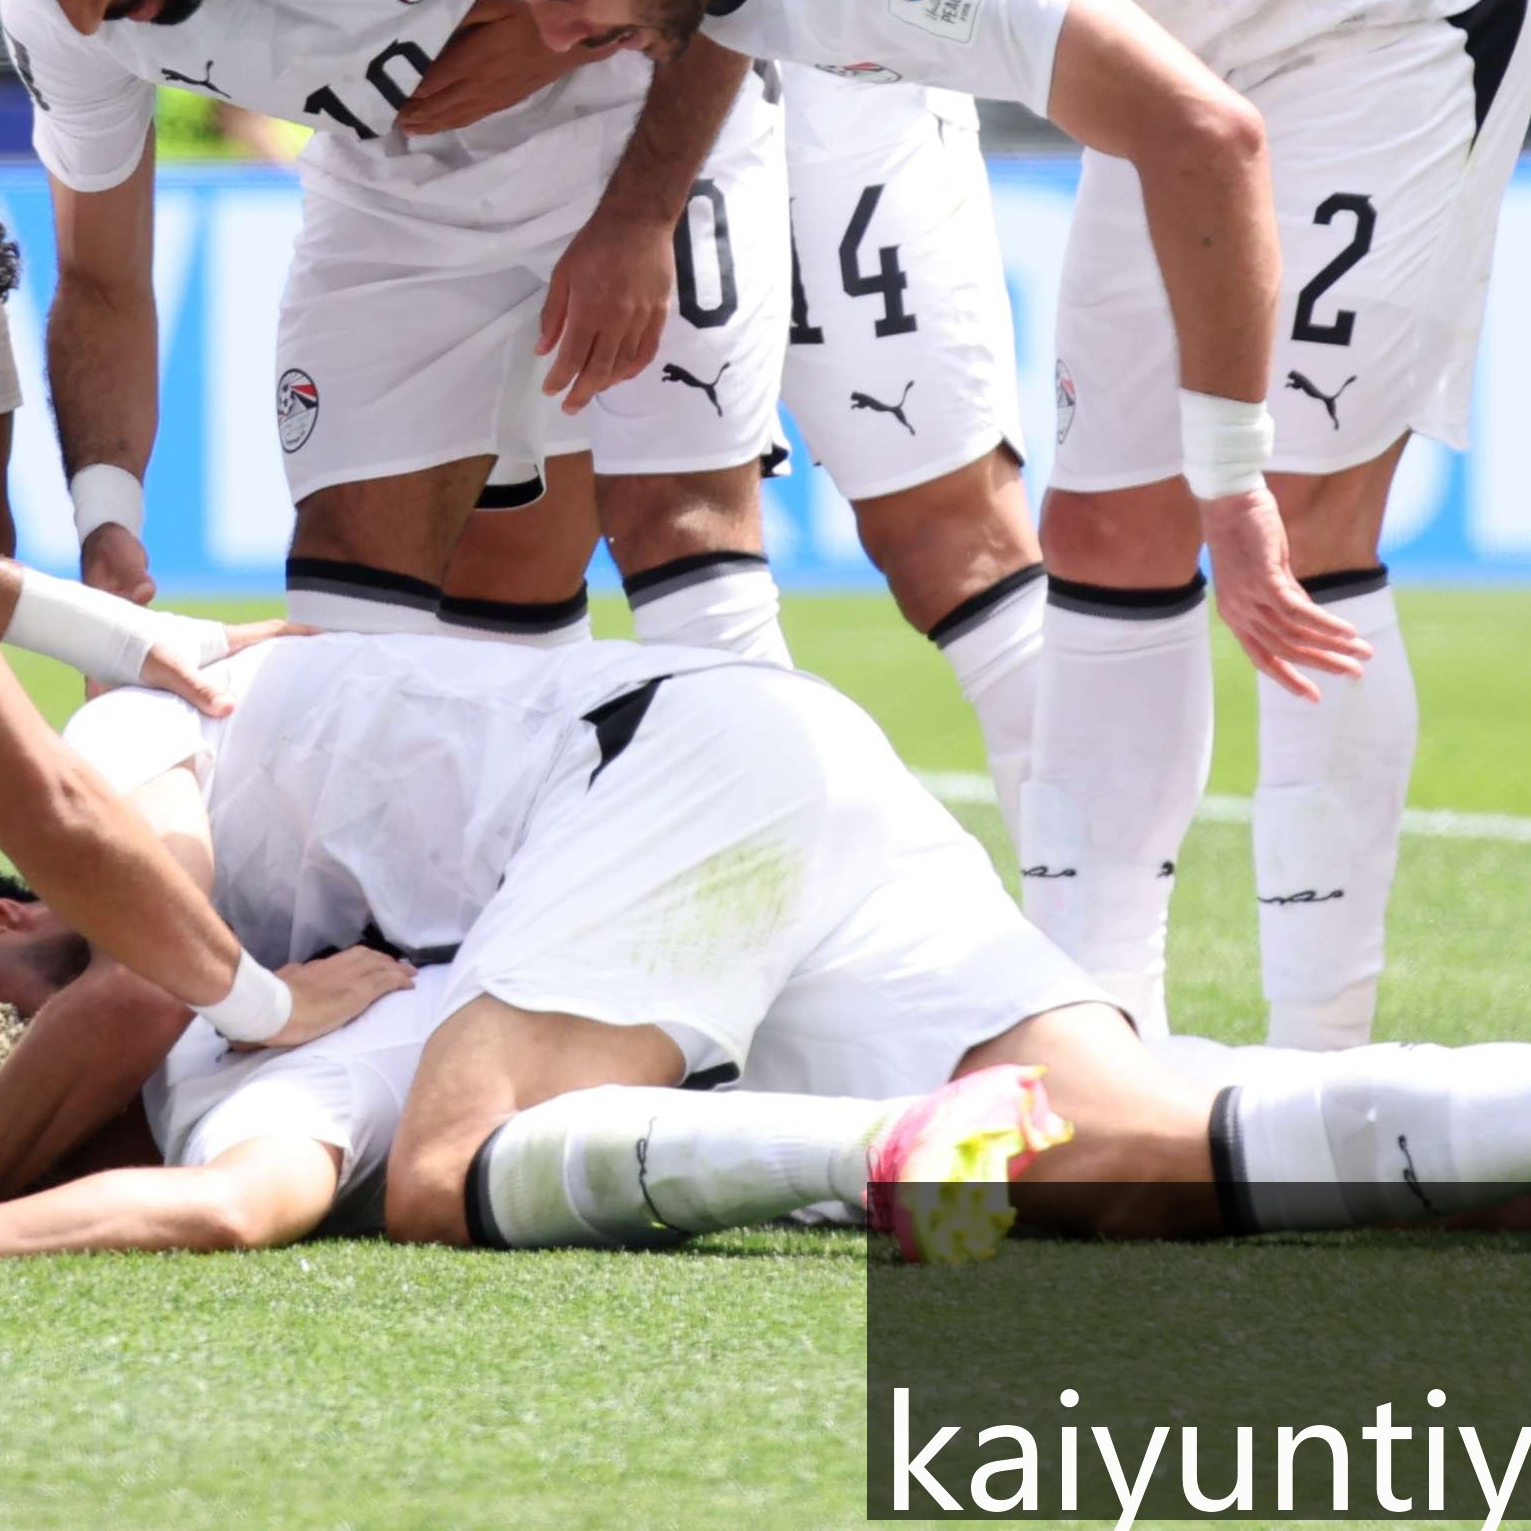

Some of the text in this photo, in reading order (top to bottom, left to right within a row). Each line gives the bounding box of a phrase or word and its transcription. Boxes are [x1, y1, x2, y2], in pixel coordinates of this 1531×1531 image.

[304, 38, 432, 141] 10
[789, 183, 919, 346] 14
[1291, 191, 1377, 347] 2
